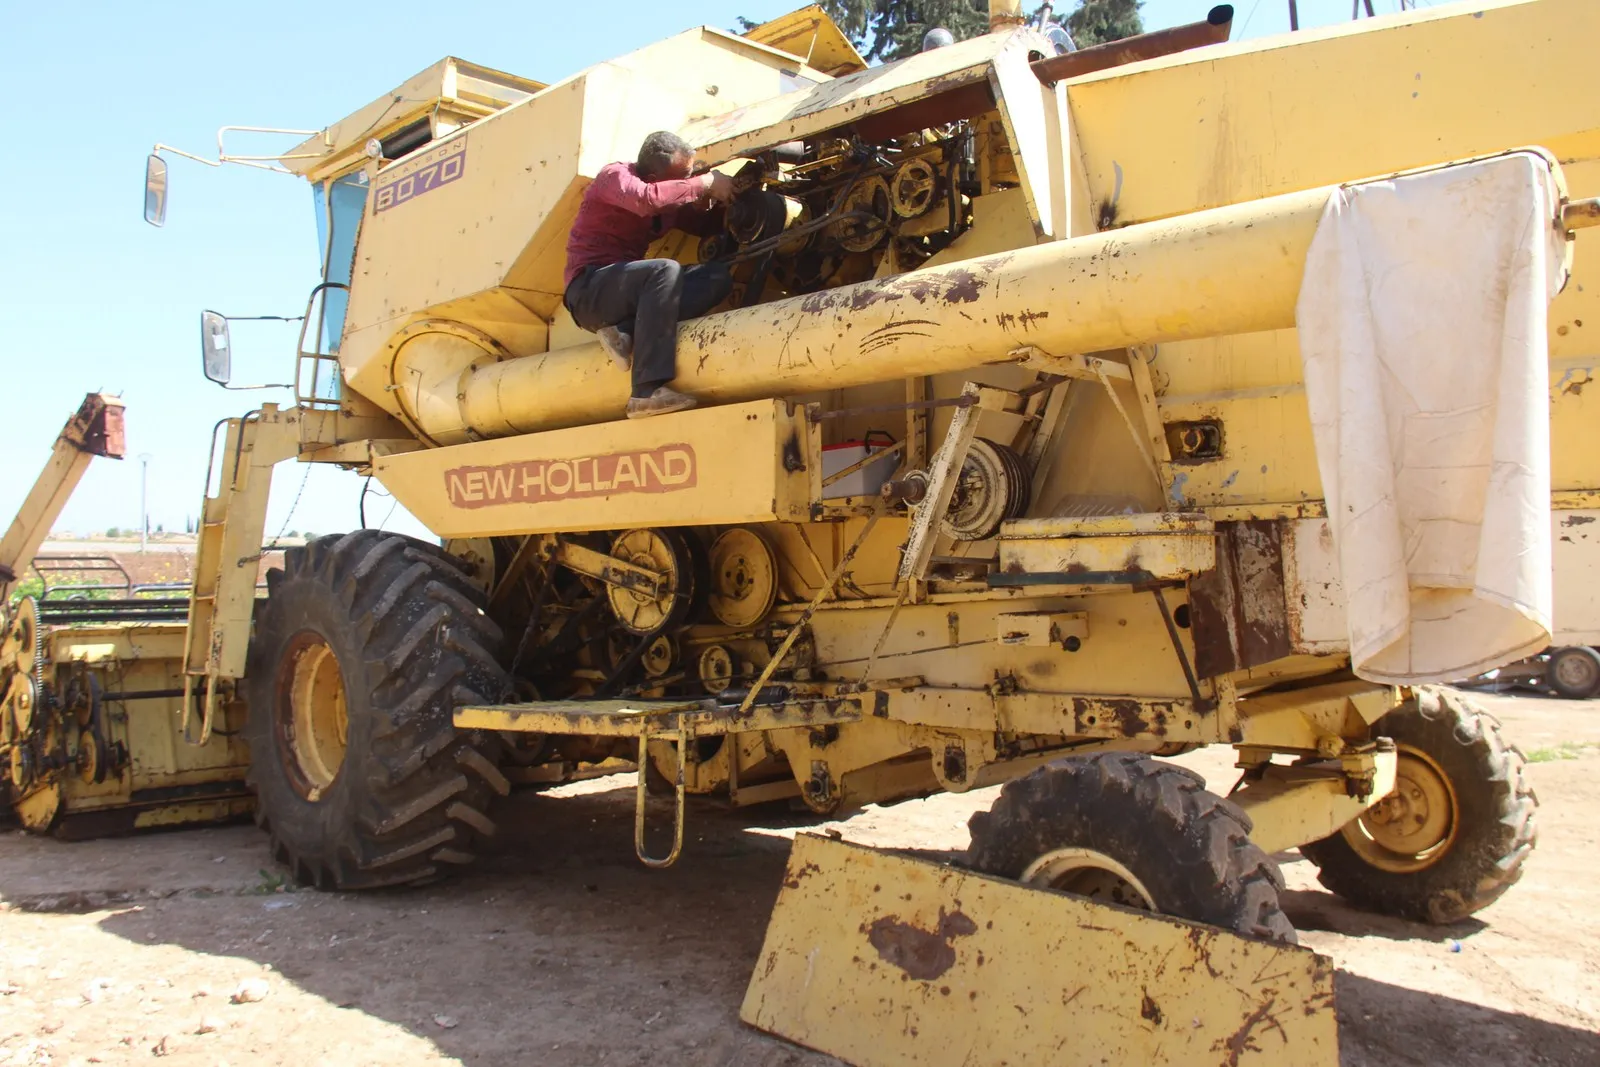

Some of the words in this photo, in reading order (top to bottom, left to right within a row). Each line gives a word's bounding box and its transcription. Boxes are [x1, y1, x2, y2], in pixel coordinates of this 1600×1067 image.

[376, 155, 462, 210] 8070
[450, 468, 515, 502] NEW
[522, 450, 692, 497] HOLLAND
